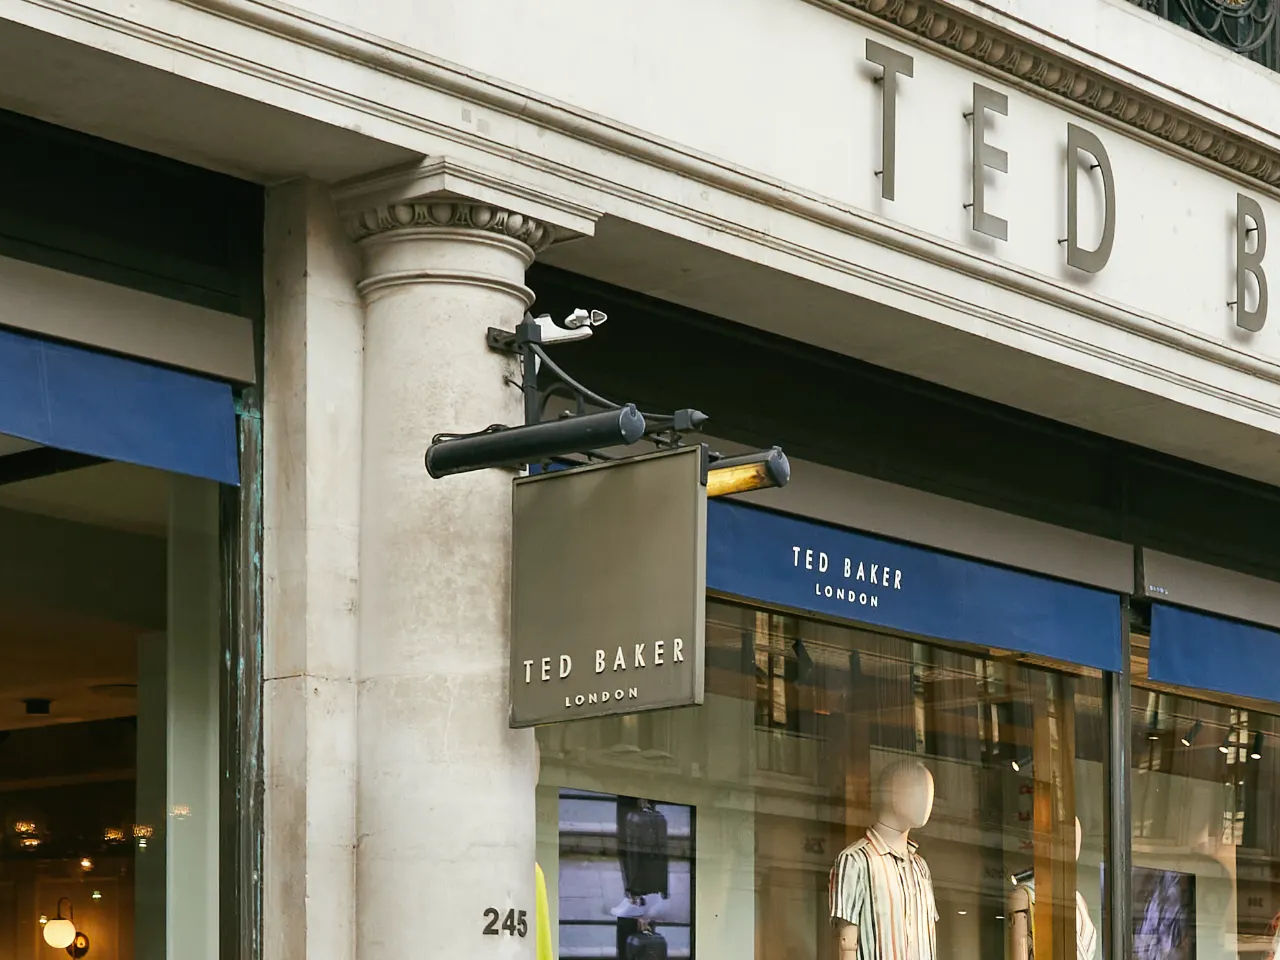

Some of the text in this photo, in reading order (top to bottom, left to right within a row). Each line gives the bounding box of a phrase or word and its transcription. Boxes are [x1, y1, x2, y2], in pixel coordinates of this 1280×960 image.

[865, 38, 1116, 274] TED
[792, 546, 902, 590] TED BAKER
[815, 583, 878, 608] LONDON
[523, 638, 684, 683] TED BAKER
[565, 687, 638, 708] LONDON
[482, 907, 528, 938] 245
